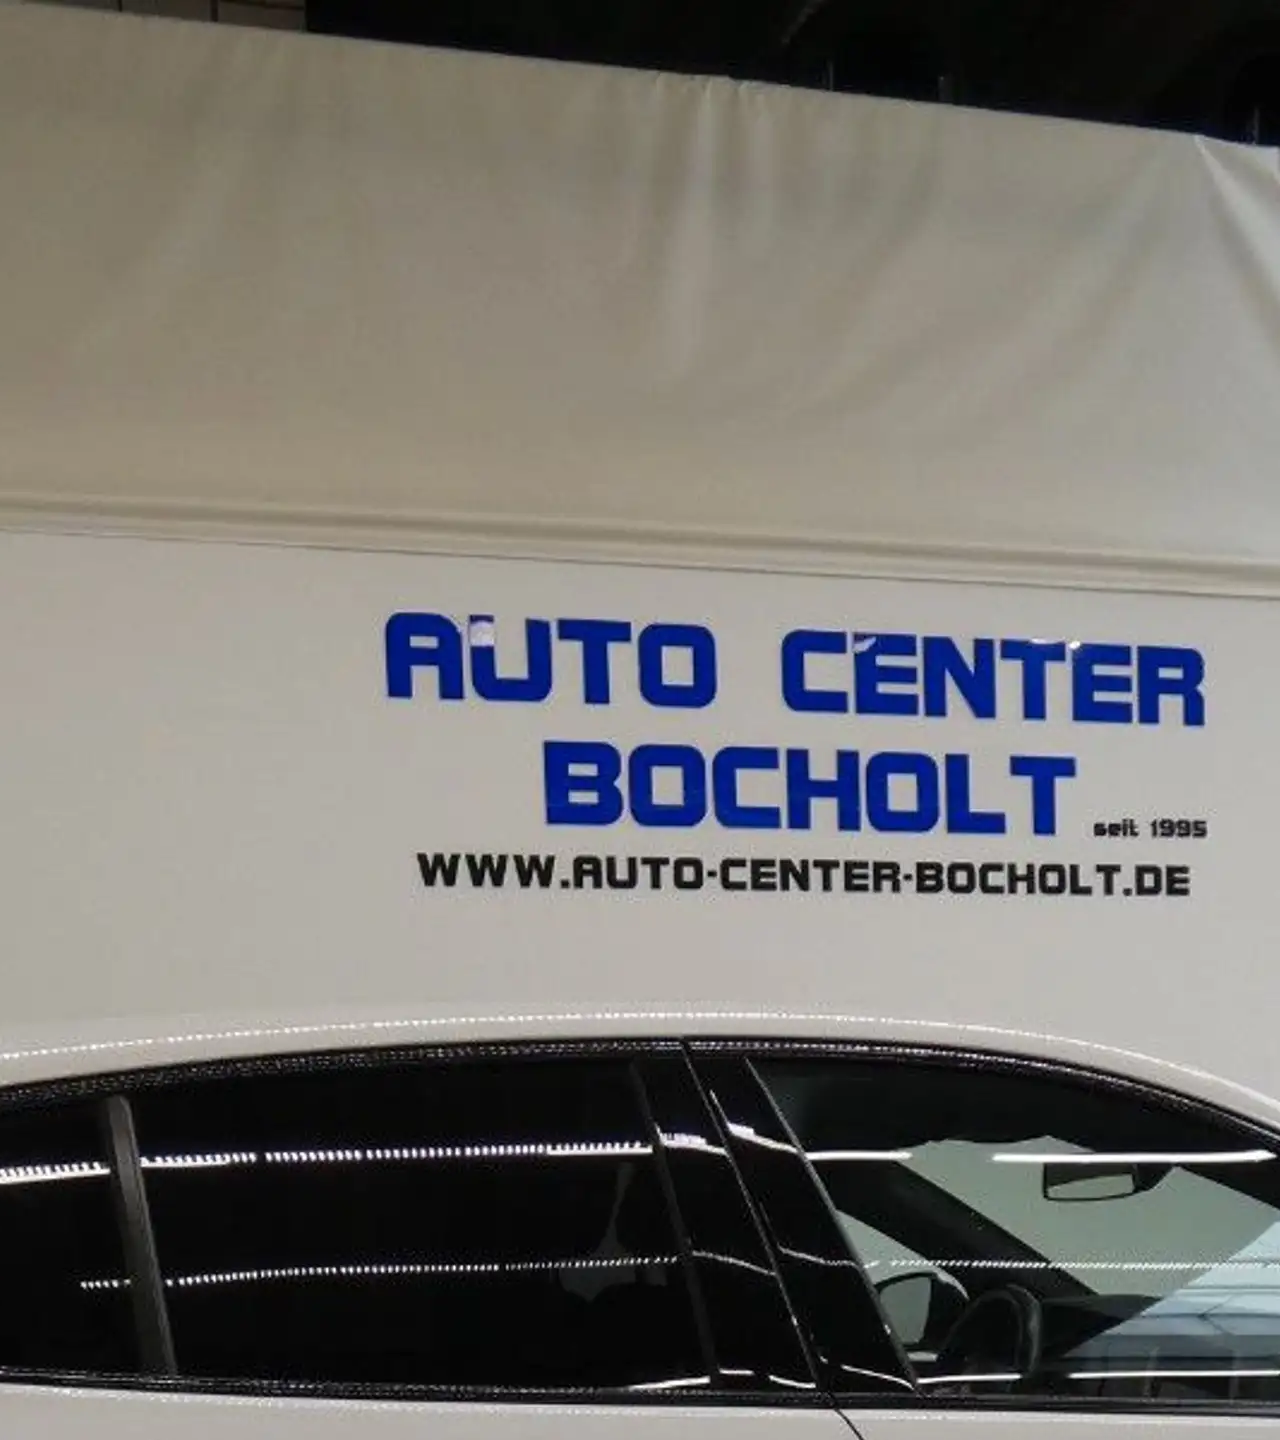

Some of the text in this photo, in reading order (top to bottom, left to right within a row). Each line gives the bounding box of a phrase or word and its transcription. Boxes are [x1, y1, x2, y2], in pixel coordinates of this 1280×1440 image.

[385, 612, 1206, 728] AUTO CENTER
[544, 740, 1077, 837] BOCHOLT
[1094, 818, 1208, 838] seit 1995
[417, 852, 1190, 897] WWW.AUTO-CENTER-BOCHOLT.DE
